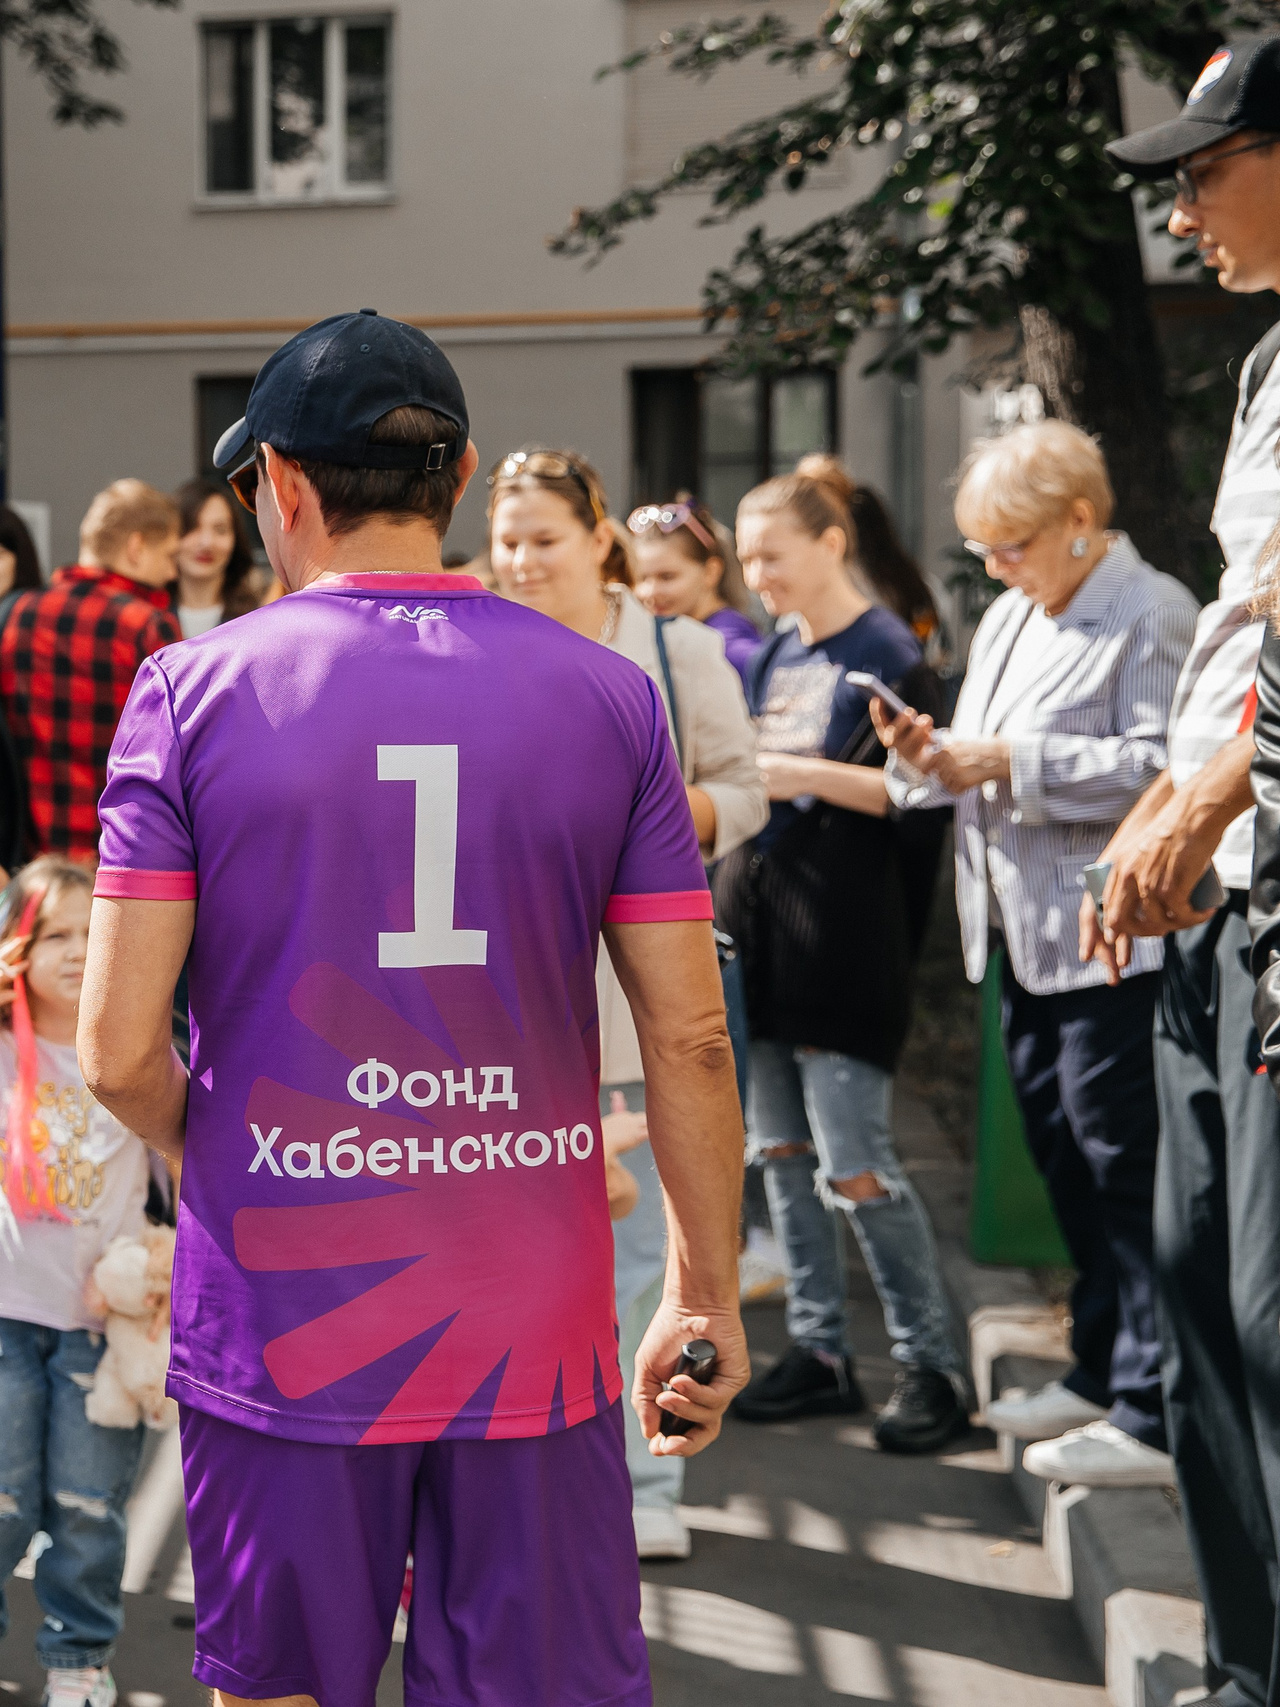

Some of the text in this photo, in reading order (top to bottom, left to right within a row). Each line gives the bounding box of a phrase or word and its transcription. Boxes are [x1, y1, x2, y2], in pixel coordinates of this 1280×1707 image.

[376, 744, 488, 968] 1
[346, 1058, 519, 1112] Фонд
[247, 1123, 594, 1179] Хабенского
